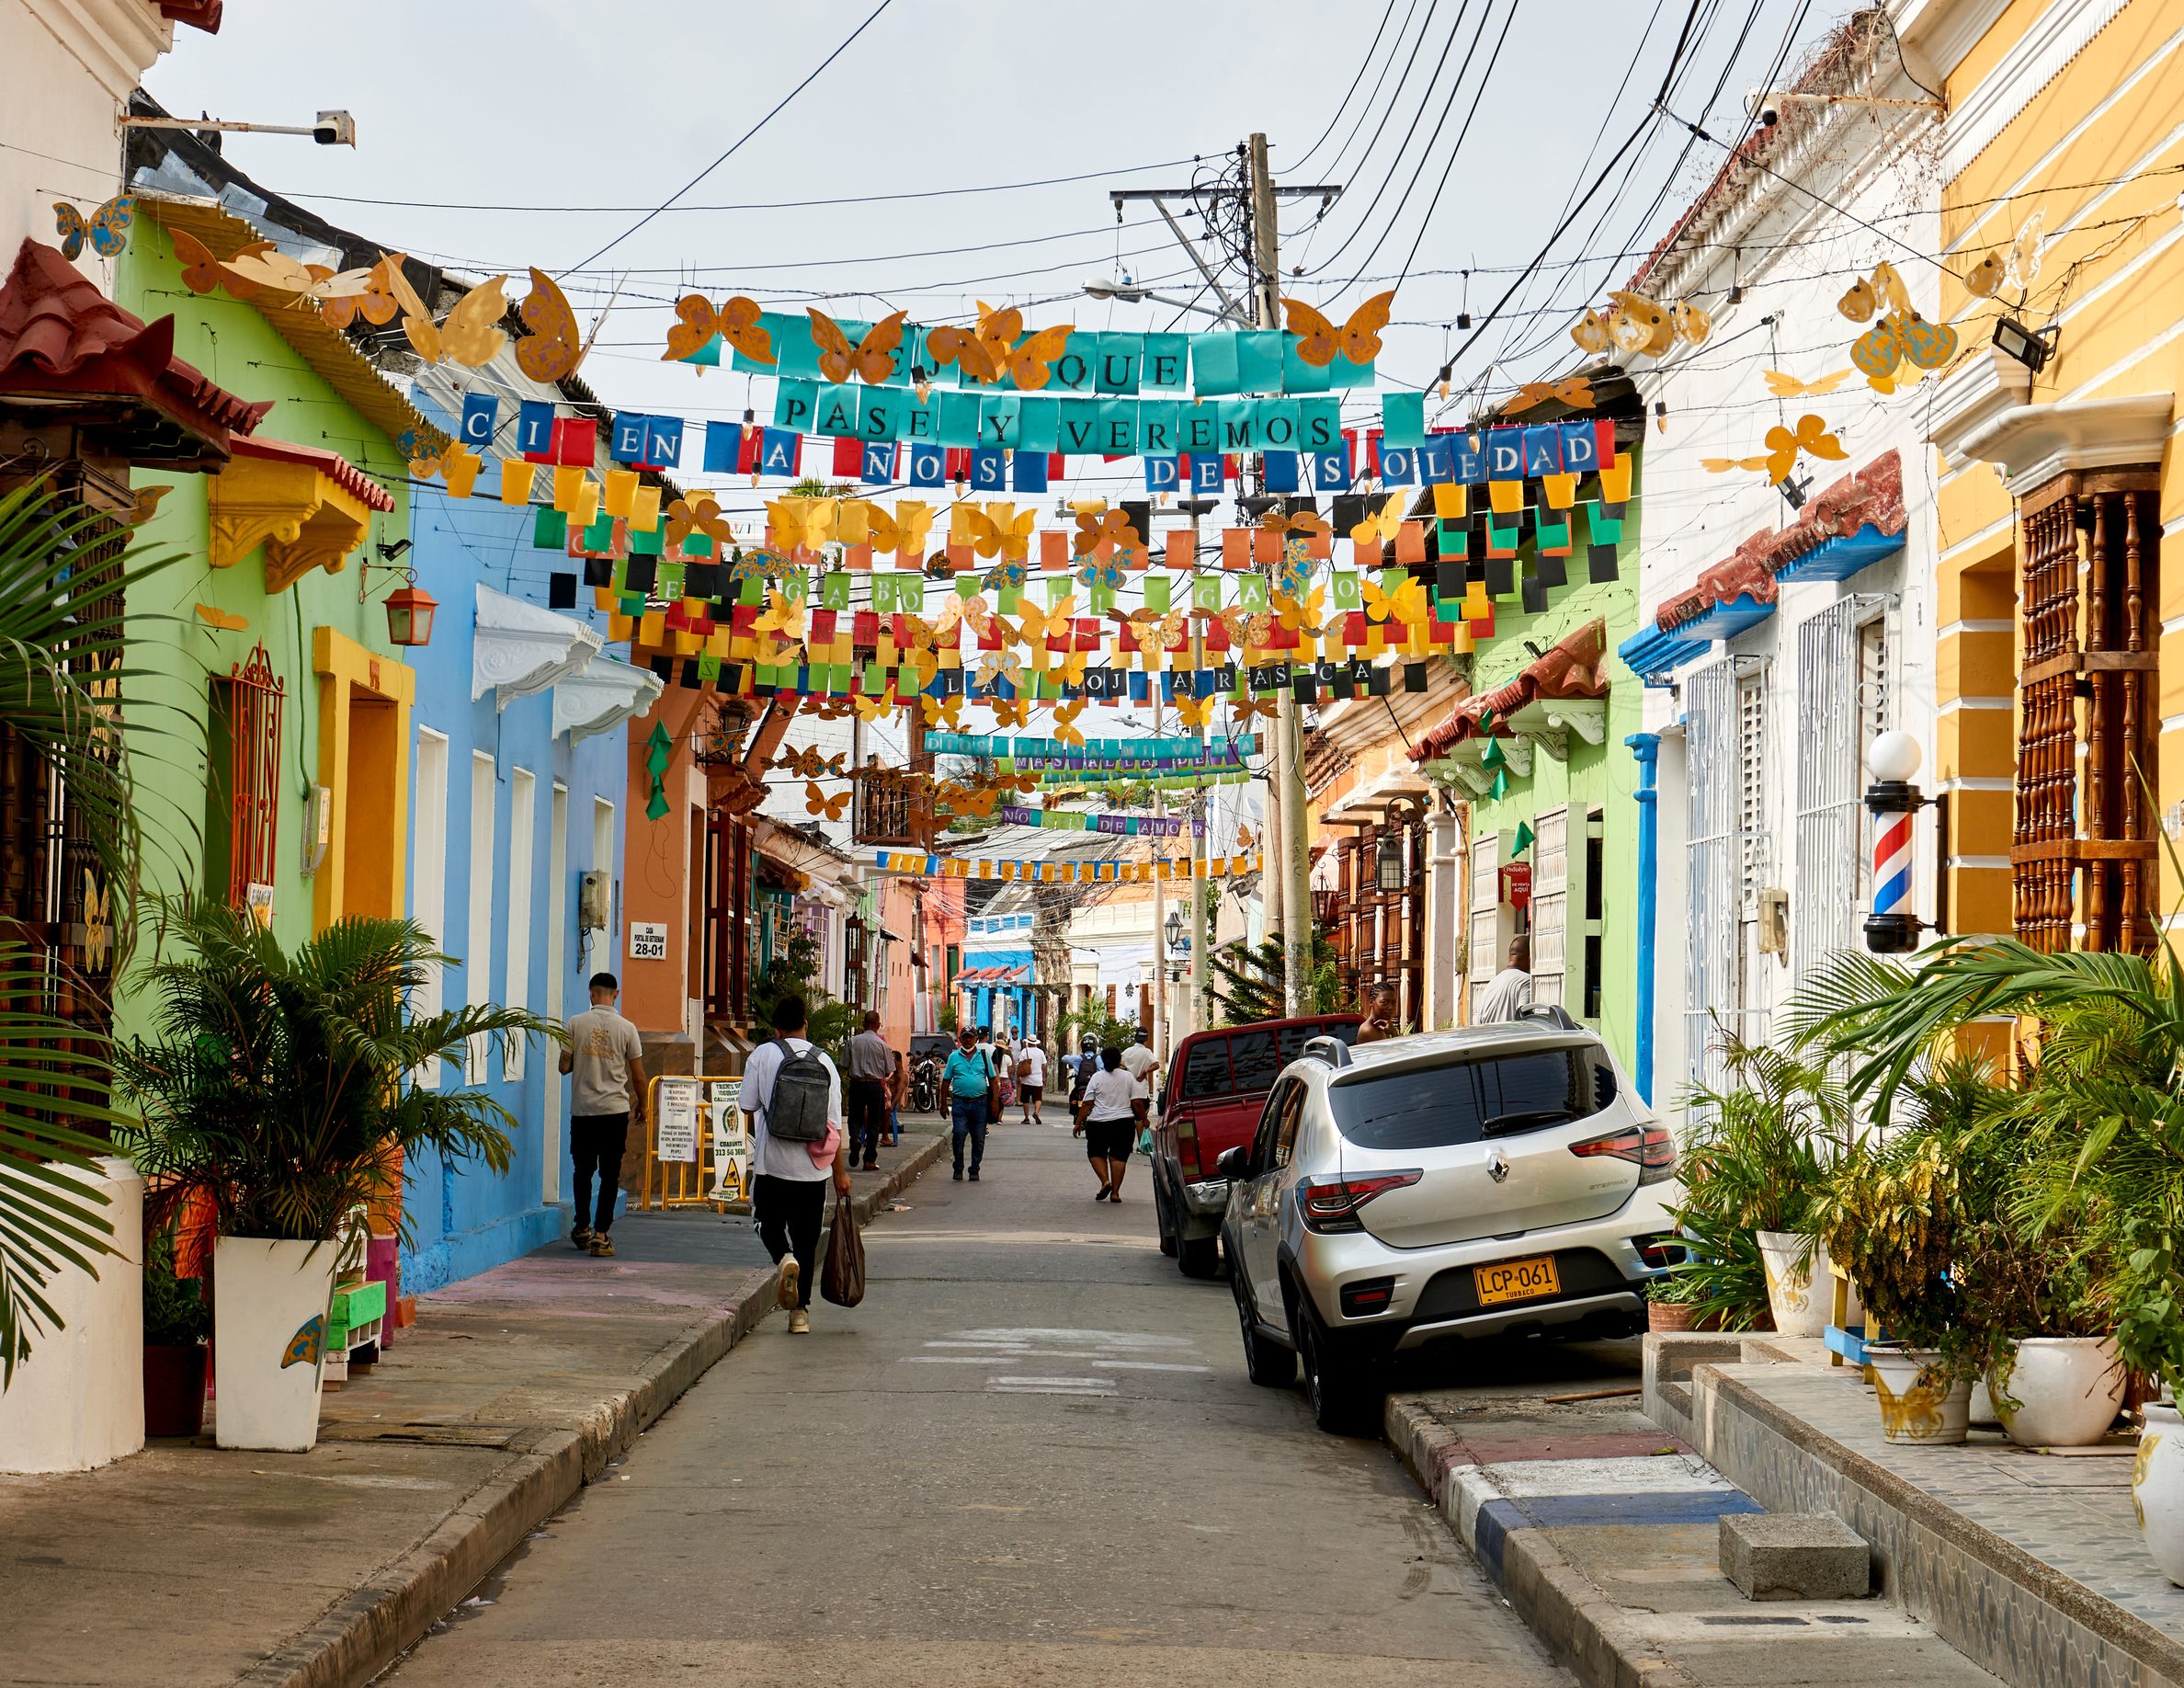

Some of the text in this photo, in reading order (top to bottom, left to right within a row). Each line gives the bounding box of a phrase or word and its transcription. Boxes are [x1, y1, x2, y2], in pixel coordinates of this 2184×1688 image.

[1058, 354, 1177, 390] QUE
[786, 398, 1330, 450] PASE Y VEREMOS
[1153, 459, 1220, 488] DE
[1324, 436, 1592, 483] SOLEDAD
[927, 737, 1252, 758] DIOS LLEVA MI VIDA
[1004, 810, 1029, 823] NO
[1099, 820, 1124, 831] DE
[1140, 822, 1206, 836] AMOR
[635, 943, 663, 956] 28-01
[1505, 1288, 1535, 1299] TURBACO
